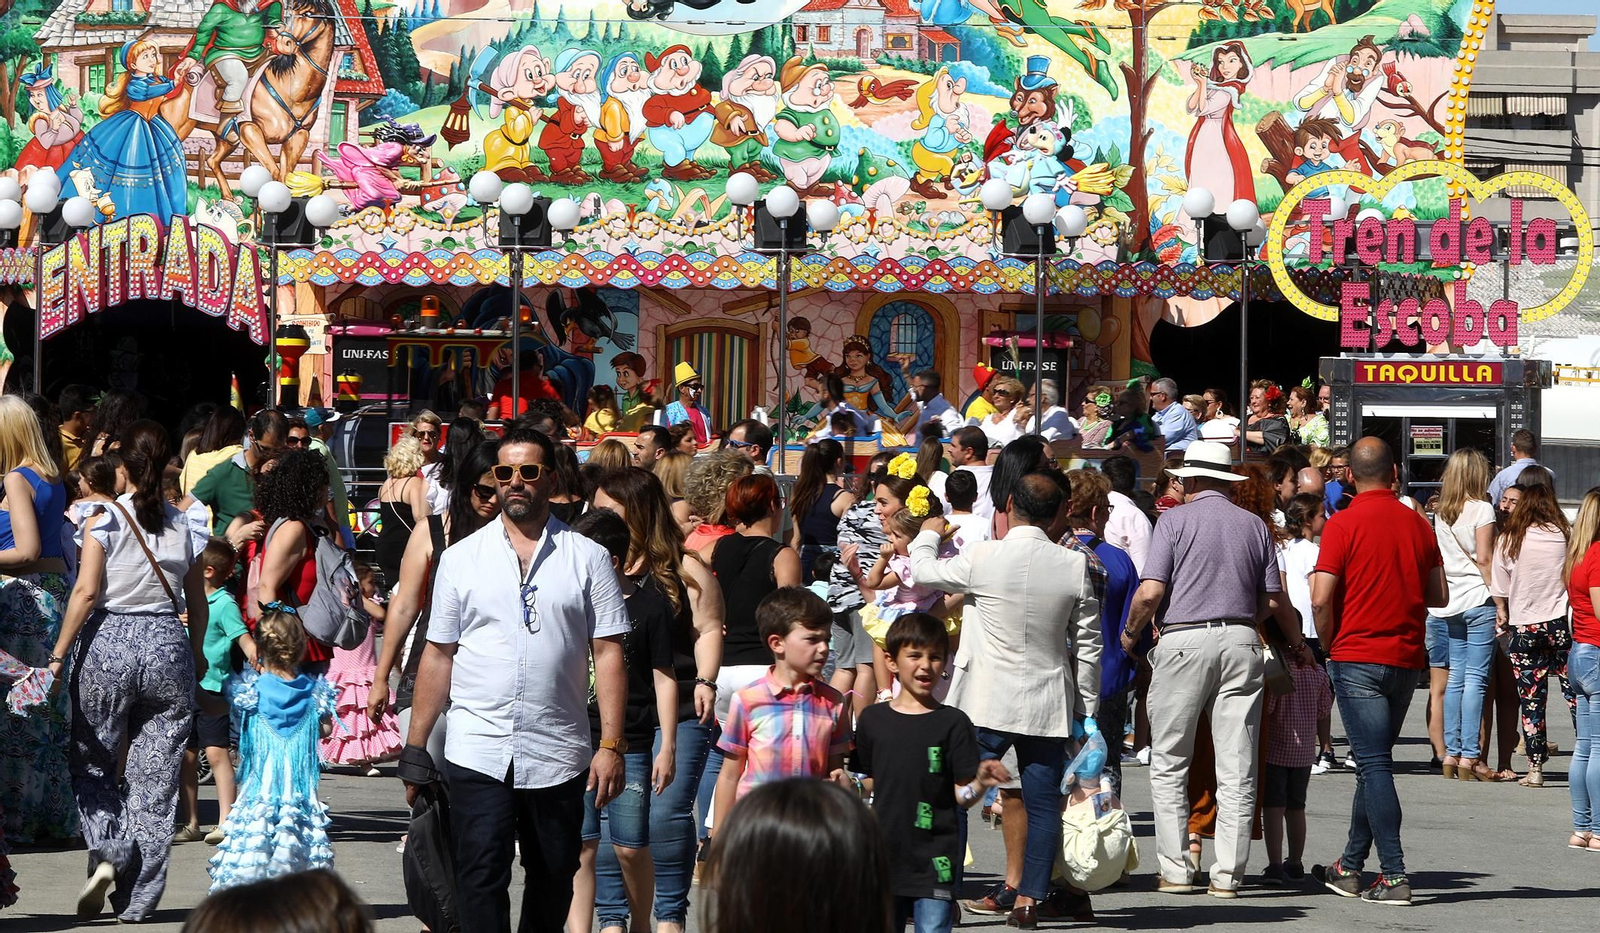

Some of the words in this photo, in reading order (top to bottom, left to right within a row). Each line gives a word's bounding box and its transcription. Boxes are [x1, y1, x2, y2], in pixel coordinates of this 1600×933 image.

[1302, 198, 1416, 265] Tren
[1430, 198, 1493, 265] de
[1509, 198, 1556, 265] la
[39, 213, 270, 346] ENTRADA
[1340, 280, 1518, 348] Escoba
[1363, 364, 1493, 384] TAQUILLA
